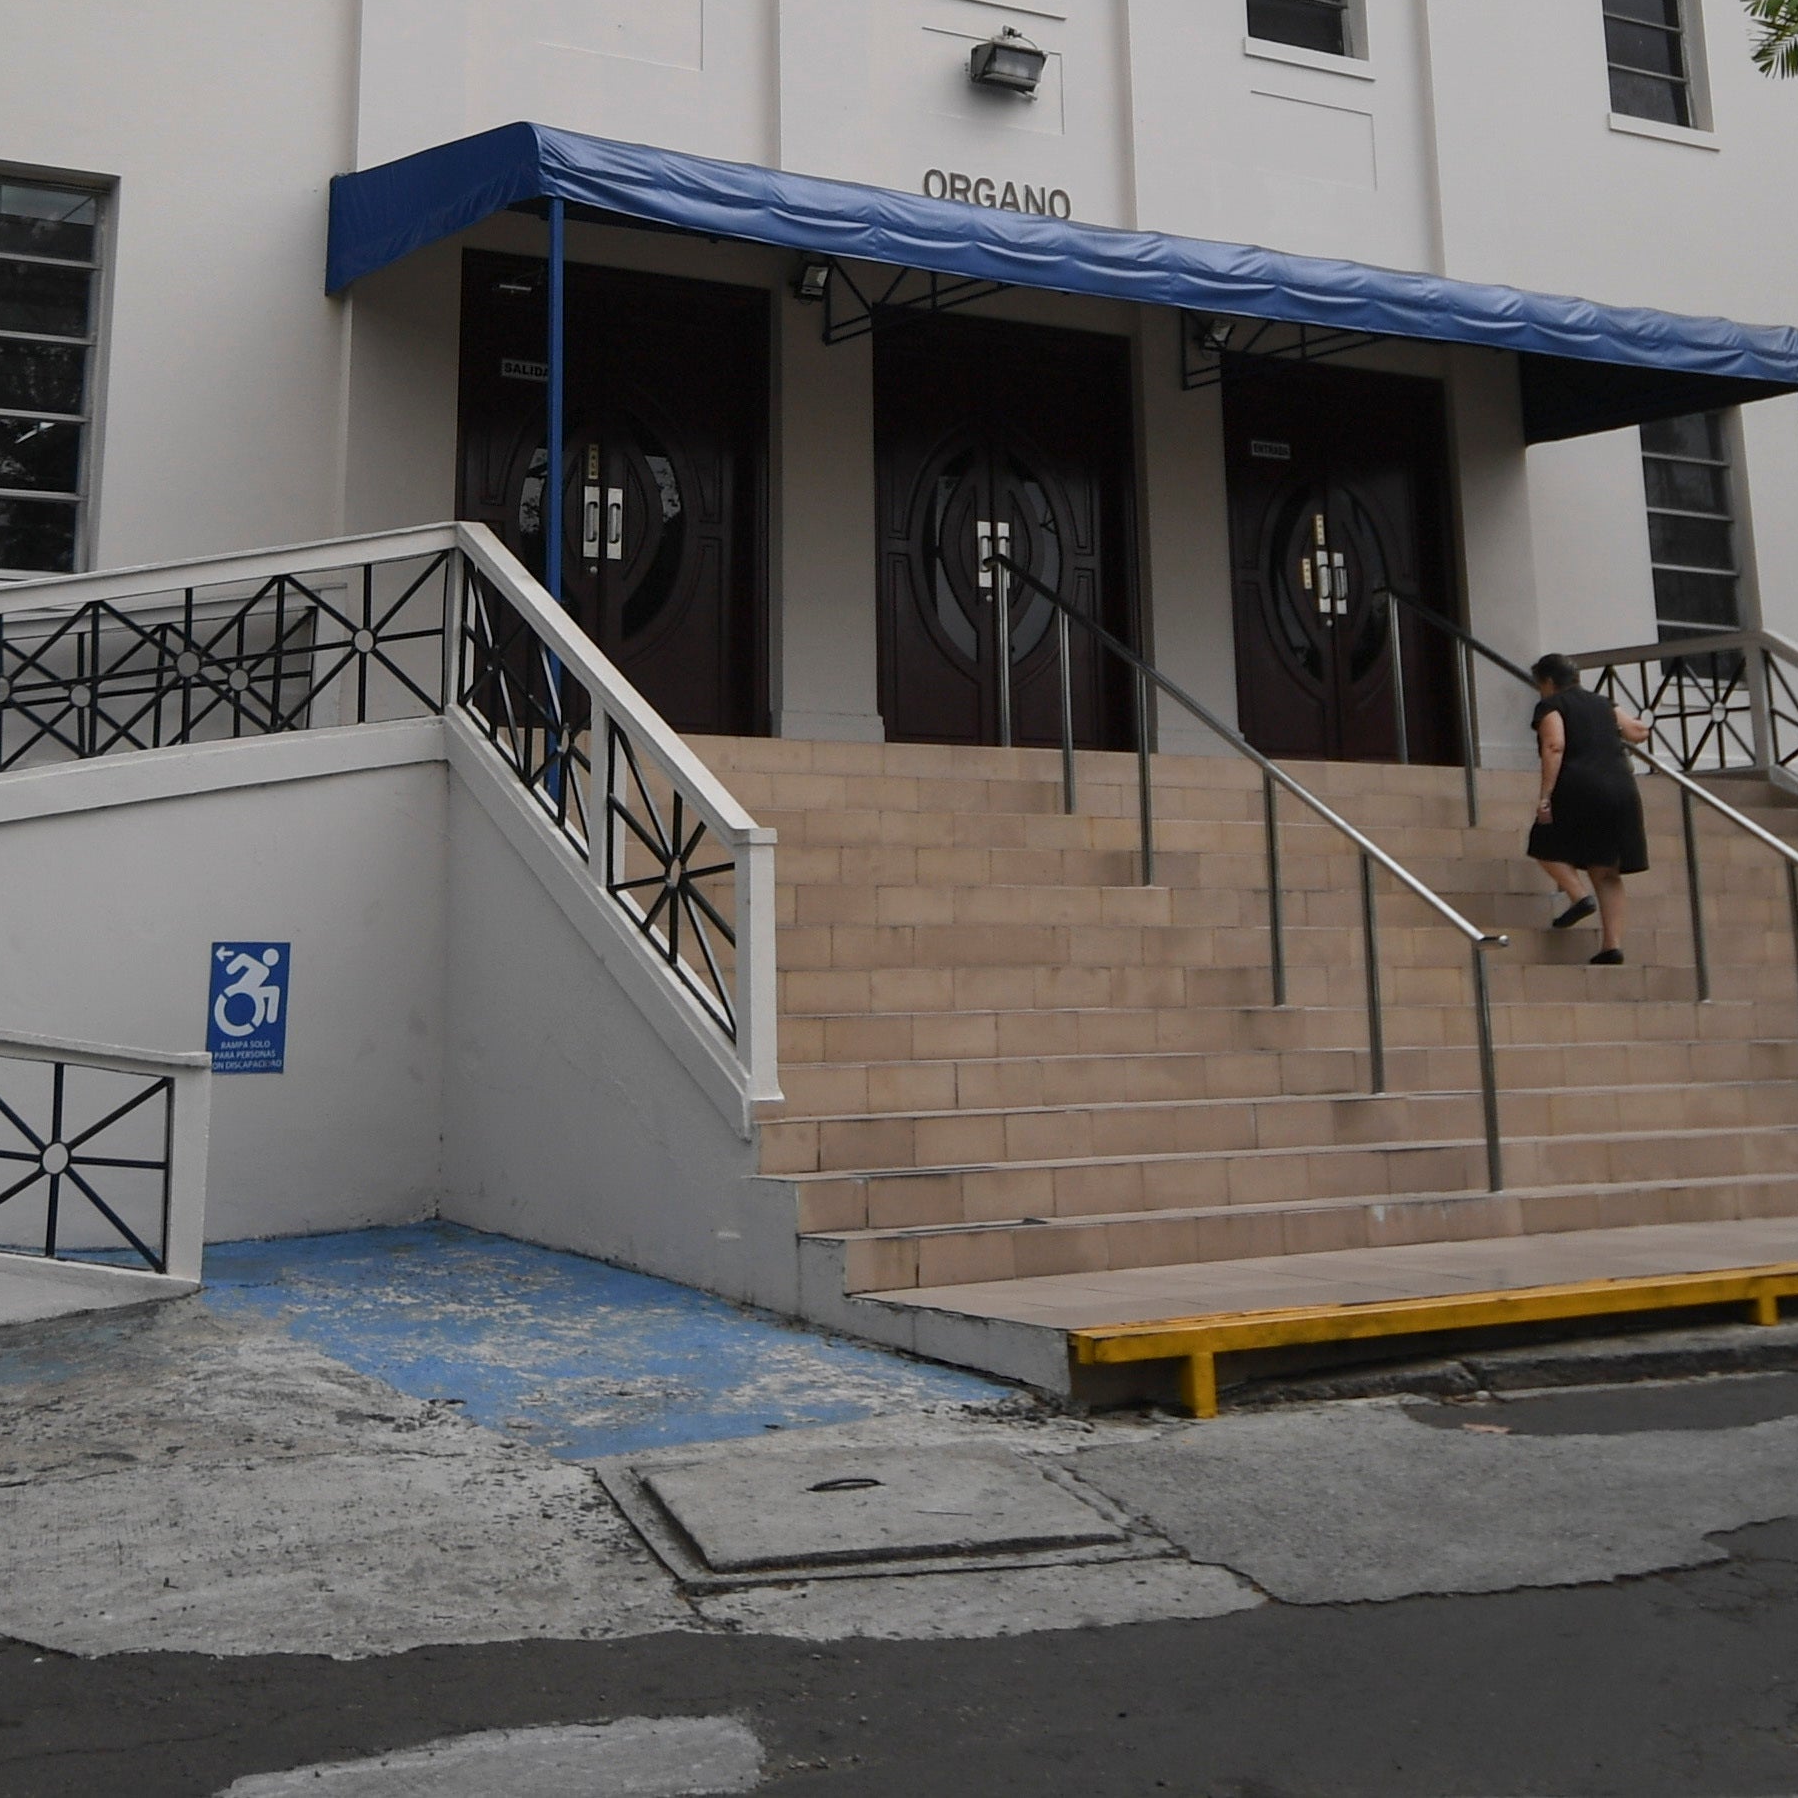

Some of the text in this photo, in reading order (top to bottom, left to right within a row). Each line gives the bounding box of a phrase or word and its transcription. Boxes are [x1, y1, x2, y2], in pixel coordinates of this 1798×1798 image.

[923, 169, 1071, 220] ORGANO
[221, 1040, 271, 1049] RAMPA SOLO
[214, 1050, 276, 1059] PARA PERSONAS
[212, 1061, 224, 1070] ON
